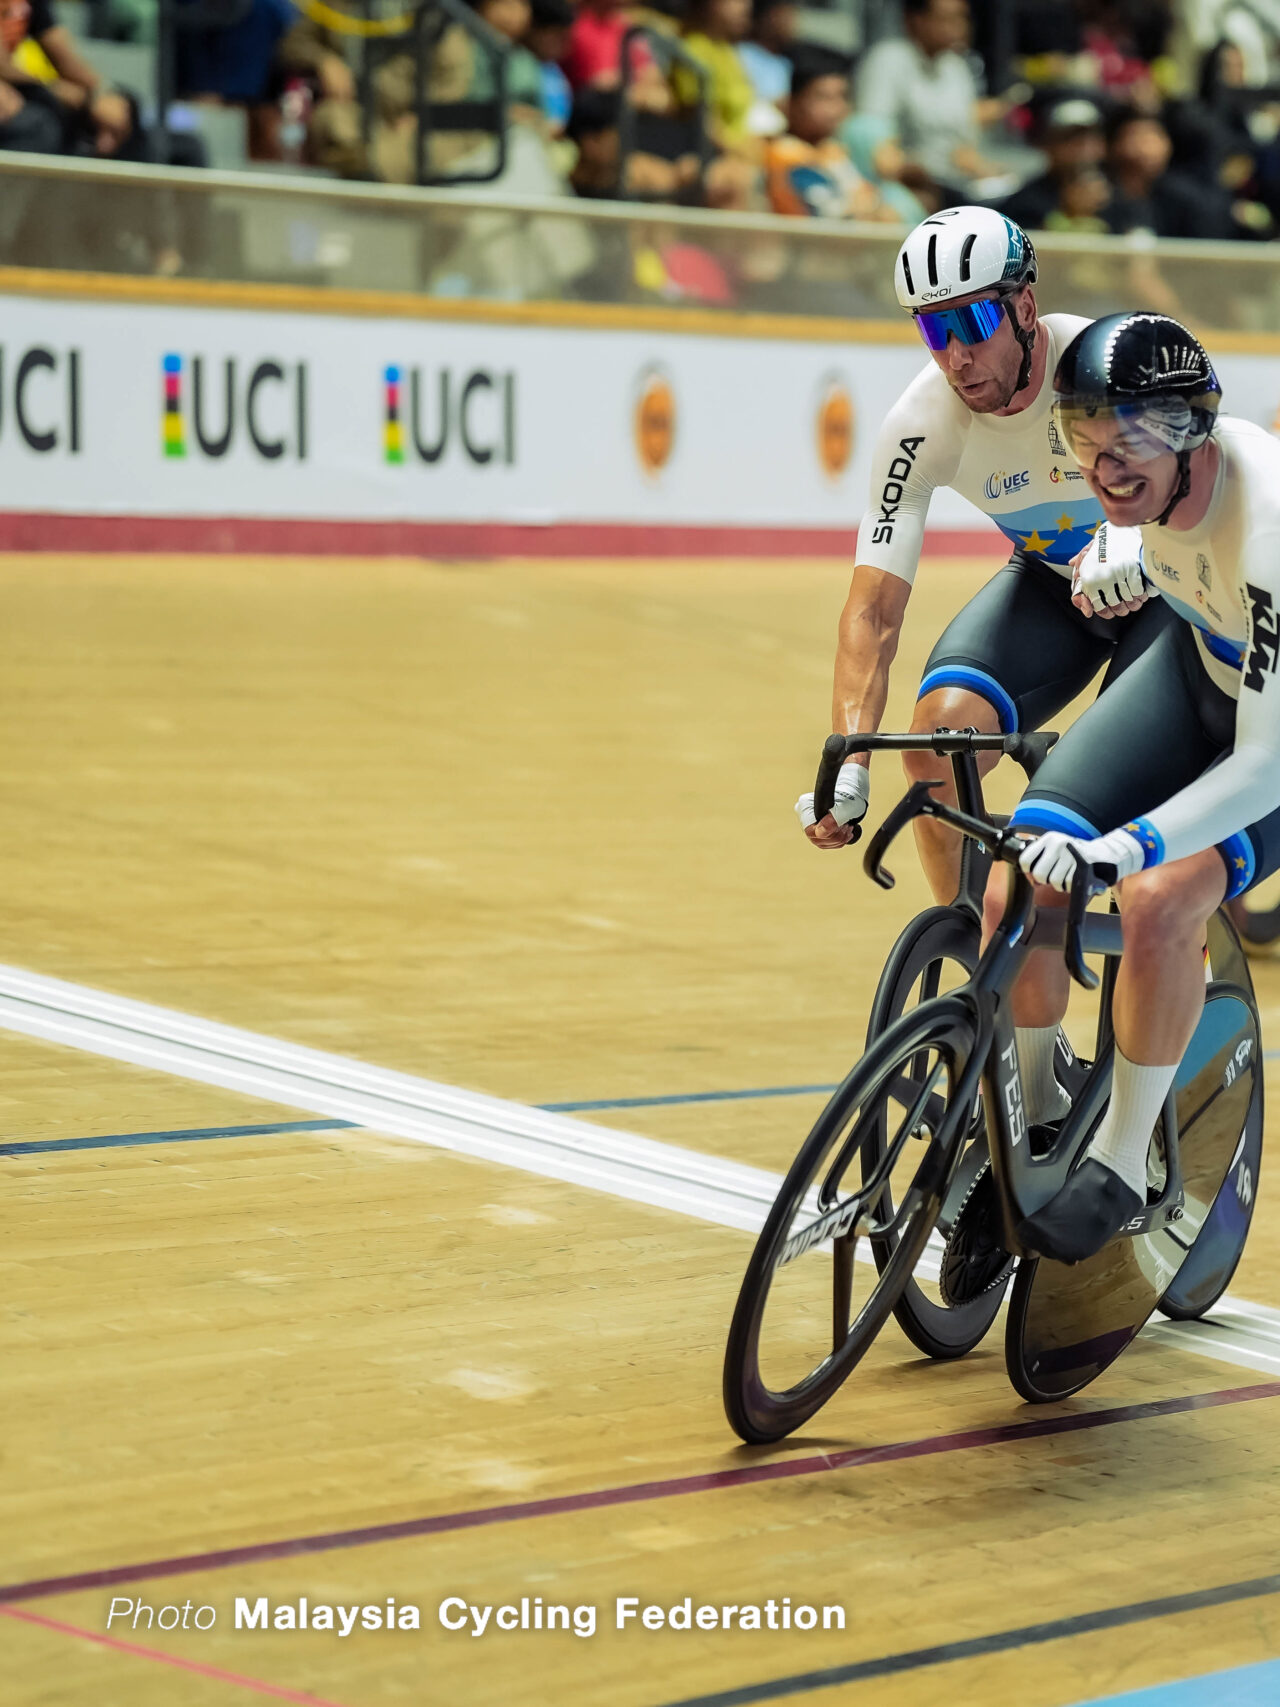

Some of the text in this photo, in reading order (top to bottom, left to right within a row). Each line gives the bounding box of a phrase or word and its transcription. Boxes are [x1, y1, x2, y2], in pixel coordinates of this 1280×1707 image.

[0, 346, 82, 454] CI
[191, 356, 308, 460] UCI
[409, 369, 515, 466] UCI
[1003, 470, 1030, 489] UEC
[1001, 1037, 1026, 1147] FES
